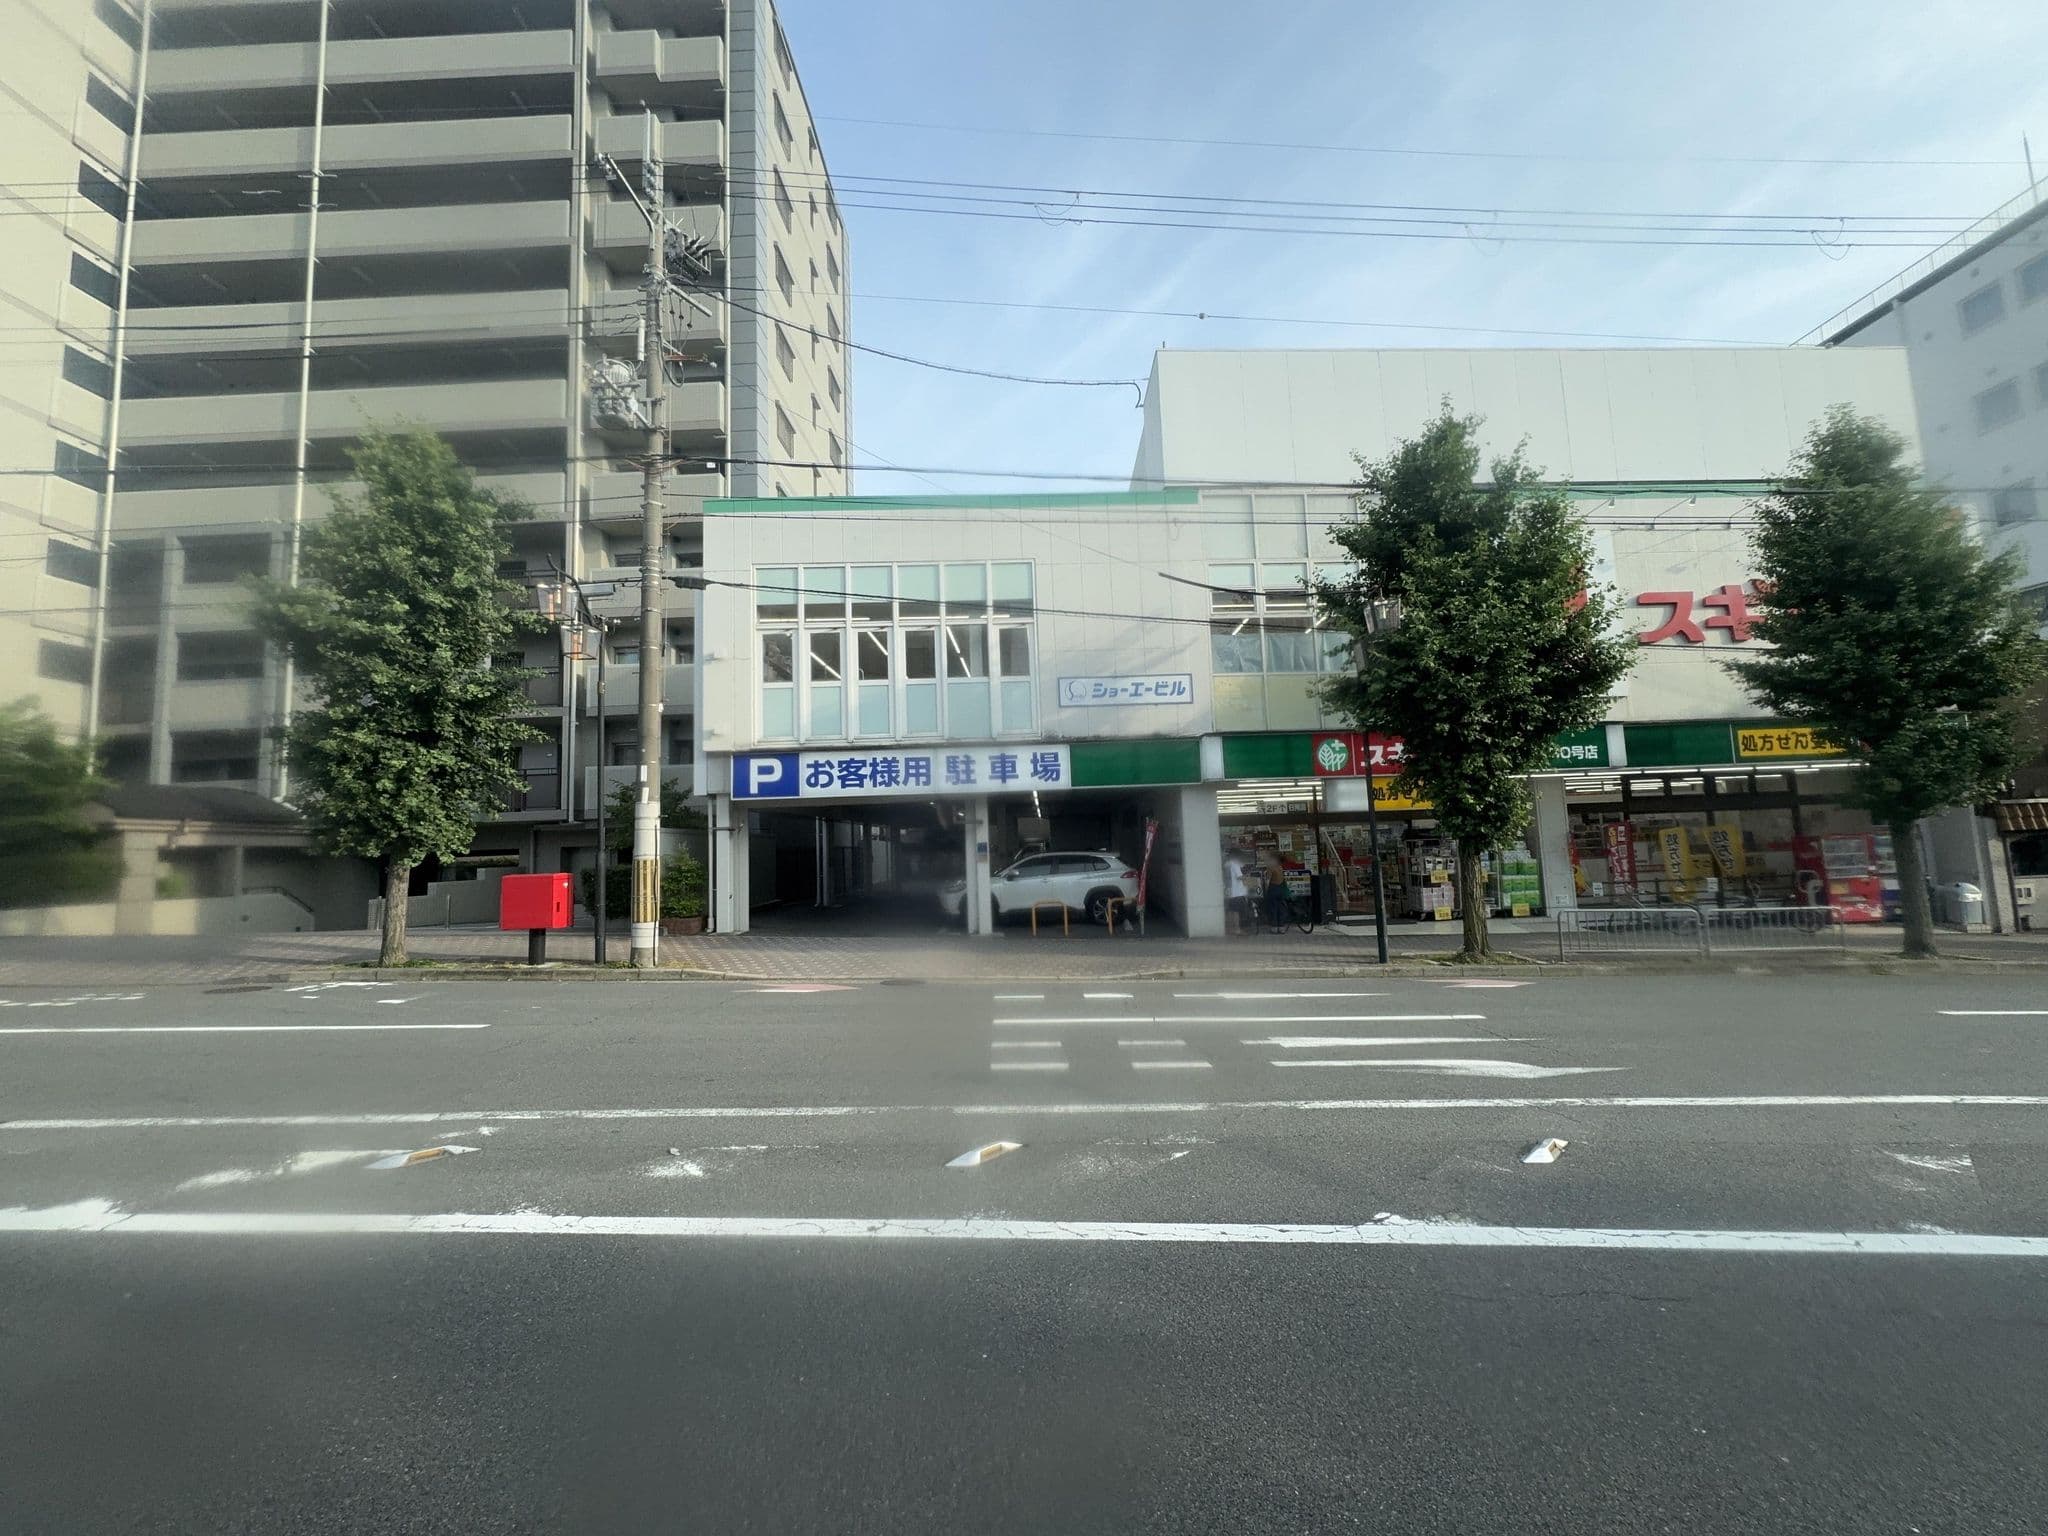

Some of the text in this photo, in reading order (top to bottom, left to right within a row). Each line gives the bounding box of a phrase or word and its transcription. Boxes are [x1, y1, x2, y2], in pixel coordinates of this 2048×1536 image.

[1092, 681, 1186, 699] ショーエービル
[1550, 744, 1599, 760] 0号店
[749, 758, 783, 794] P
